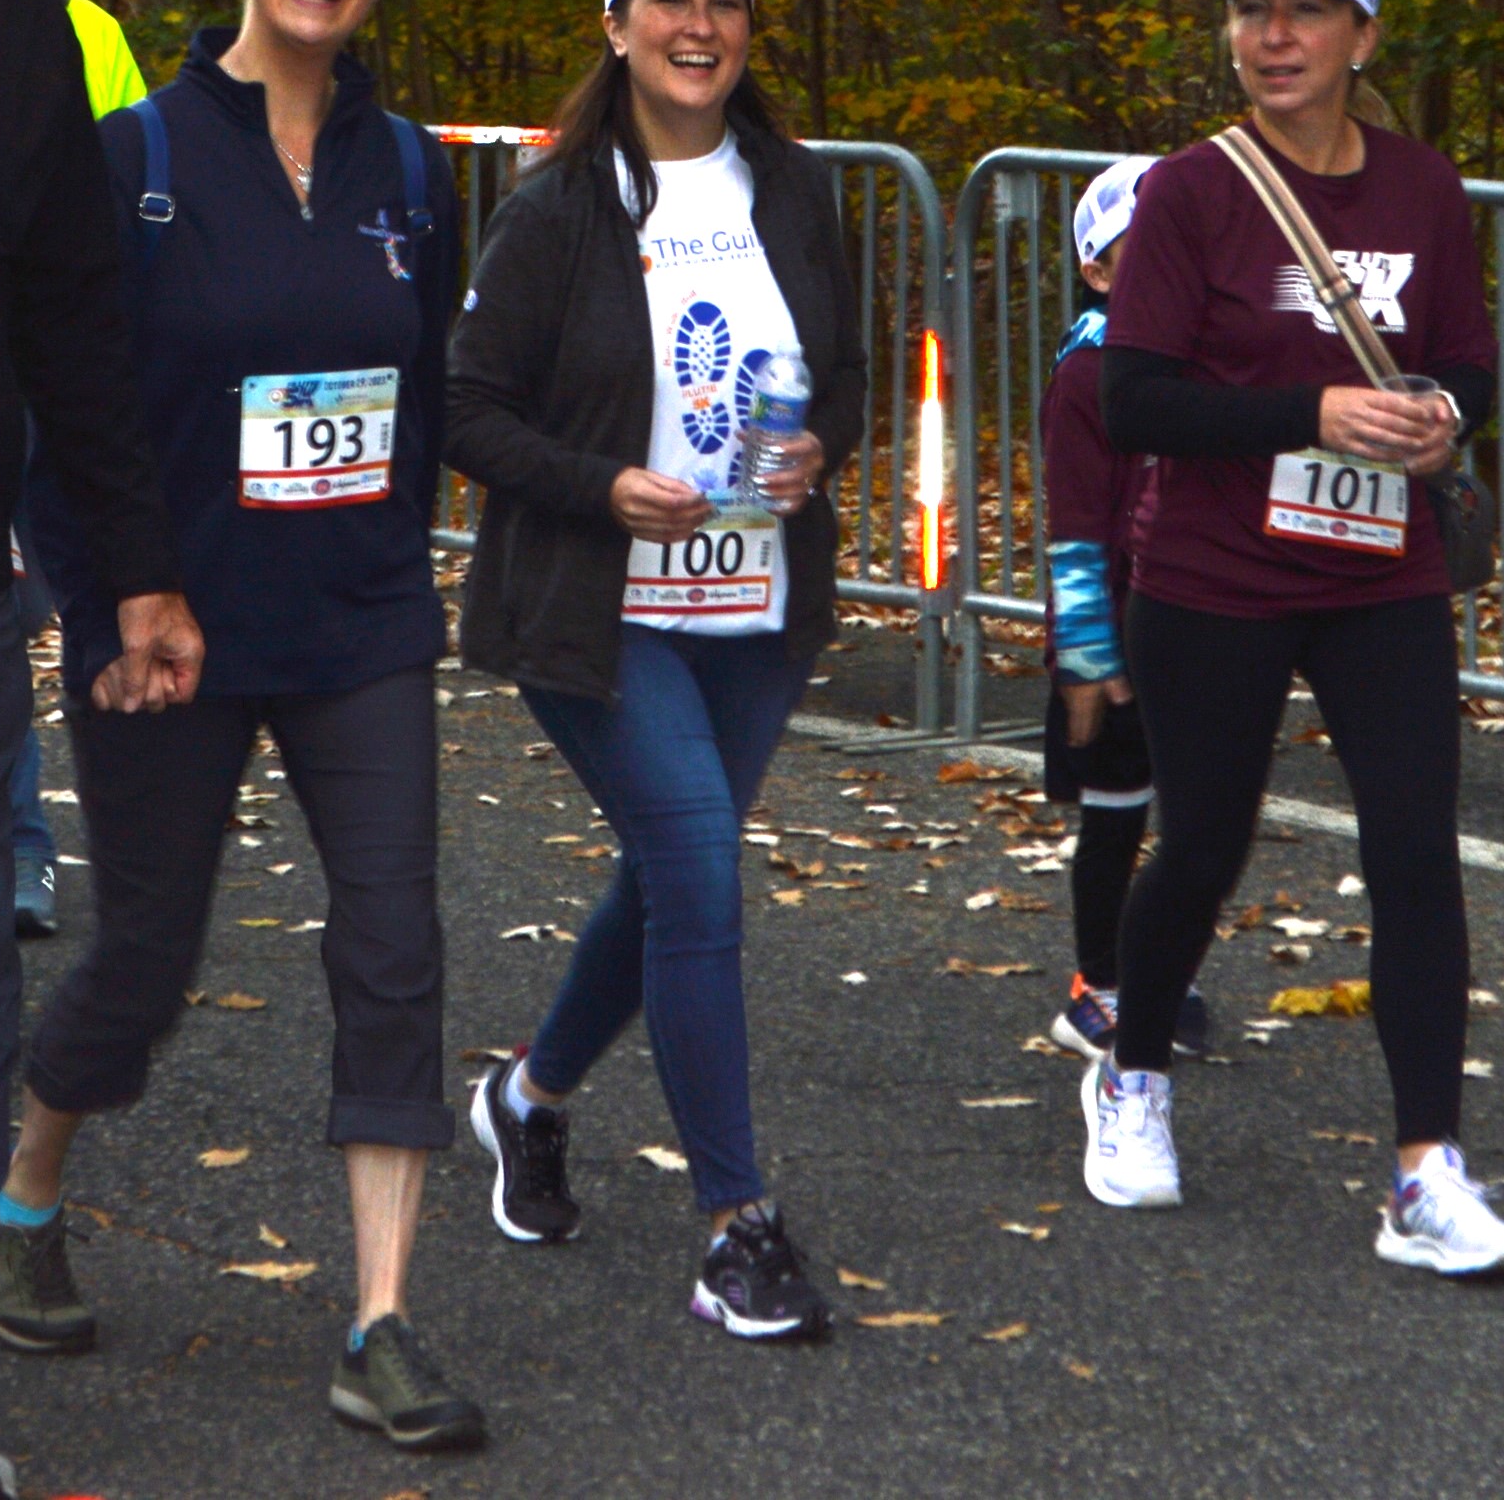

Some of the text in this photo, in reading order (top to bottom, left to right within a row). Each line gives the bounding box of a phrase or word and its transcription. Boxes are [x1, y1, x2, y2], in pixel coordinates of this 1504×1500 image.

[651, 227, 758, 259] The Gui
[274, 415, 364, 468] 193
[1304, 461, 1381, 516] 101
[661, 531, 744, 577] 100
